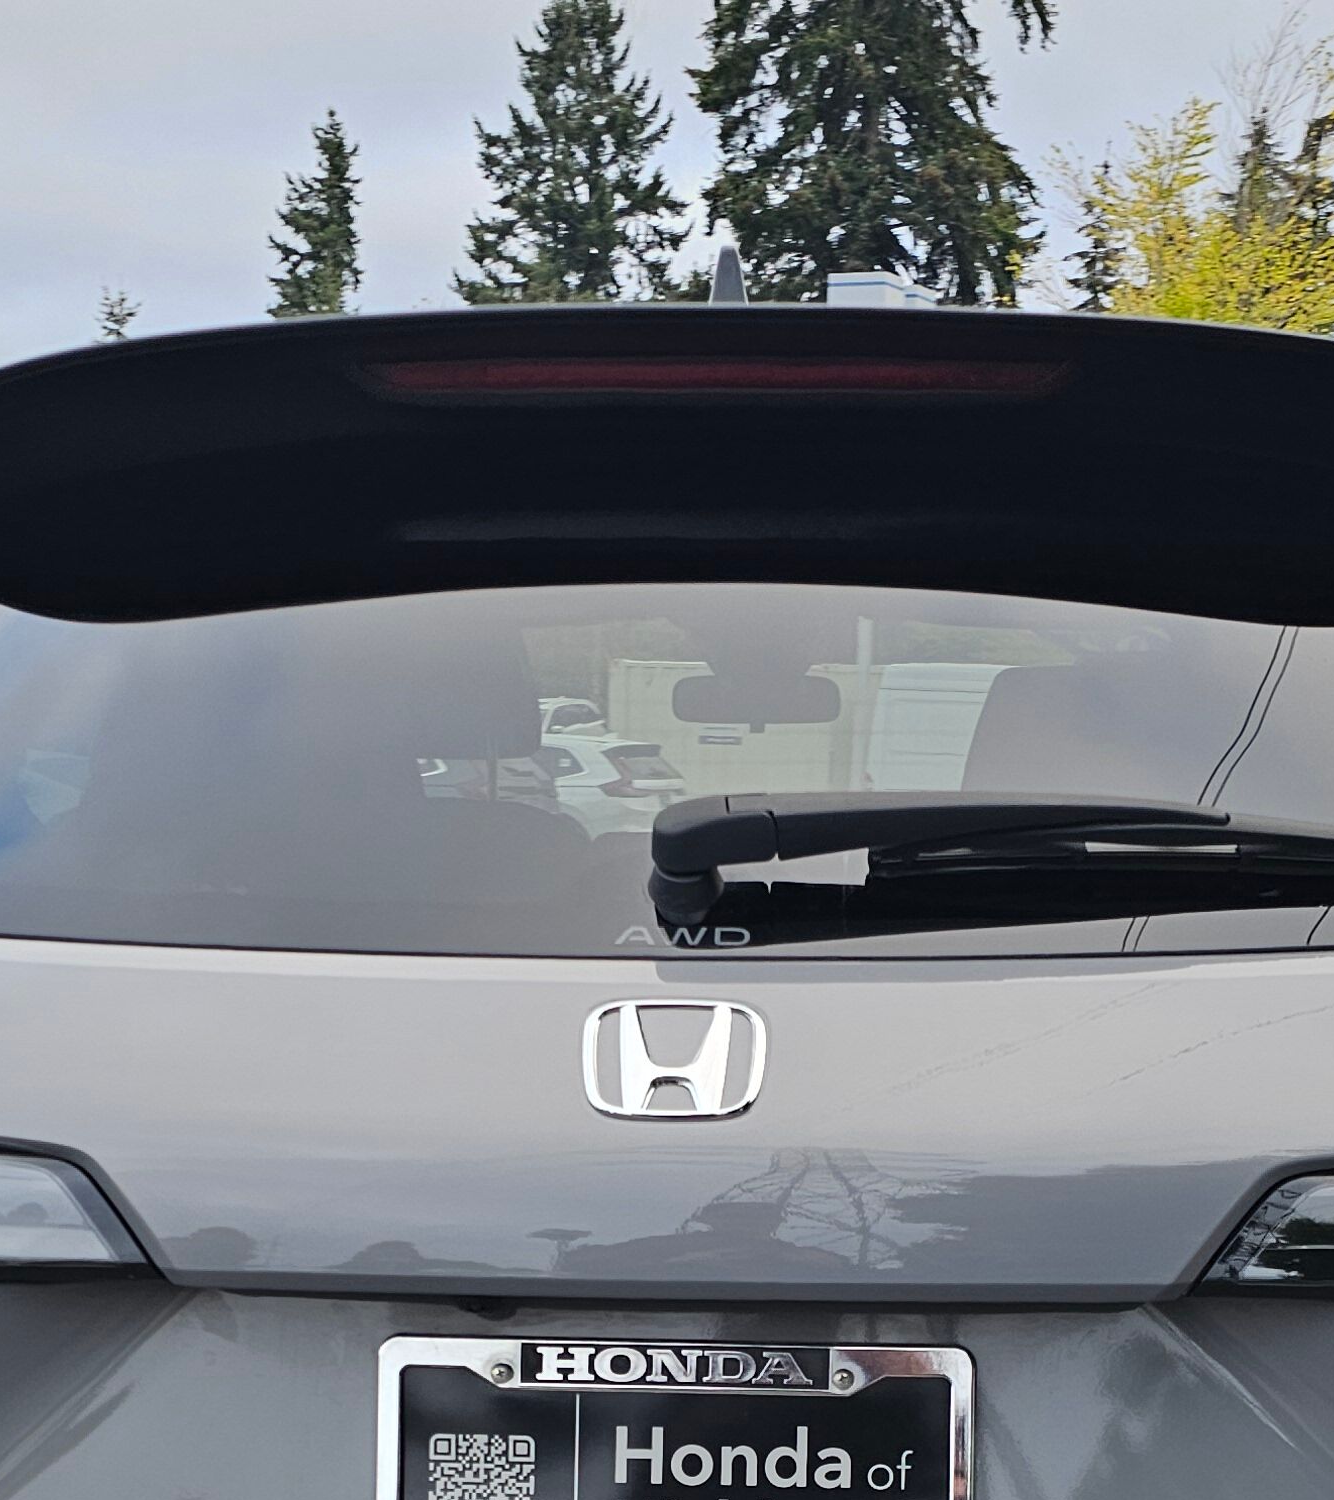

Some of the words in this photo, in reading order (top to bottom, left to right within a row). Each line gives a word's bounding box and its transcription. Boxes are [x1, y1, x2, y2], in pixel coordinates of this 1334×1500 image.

[614, 925, 751, 946] AWD
[535, 1345, 814, 1386] HONDA
[612, 1425, 853, 1489] Honda
[867, 1450, 914, 1491] of
